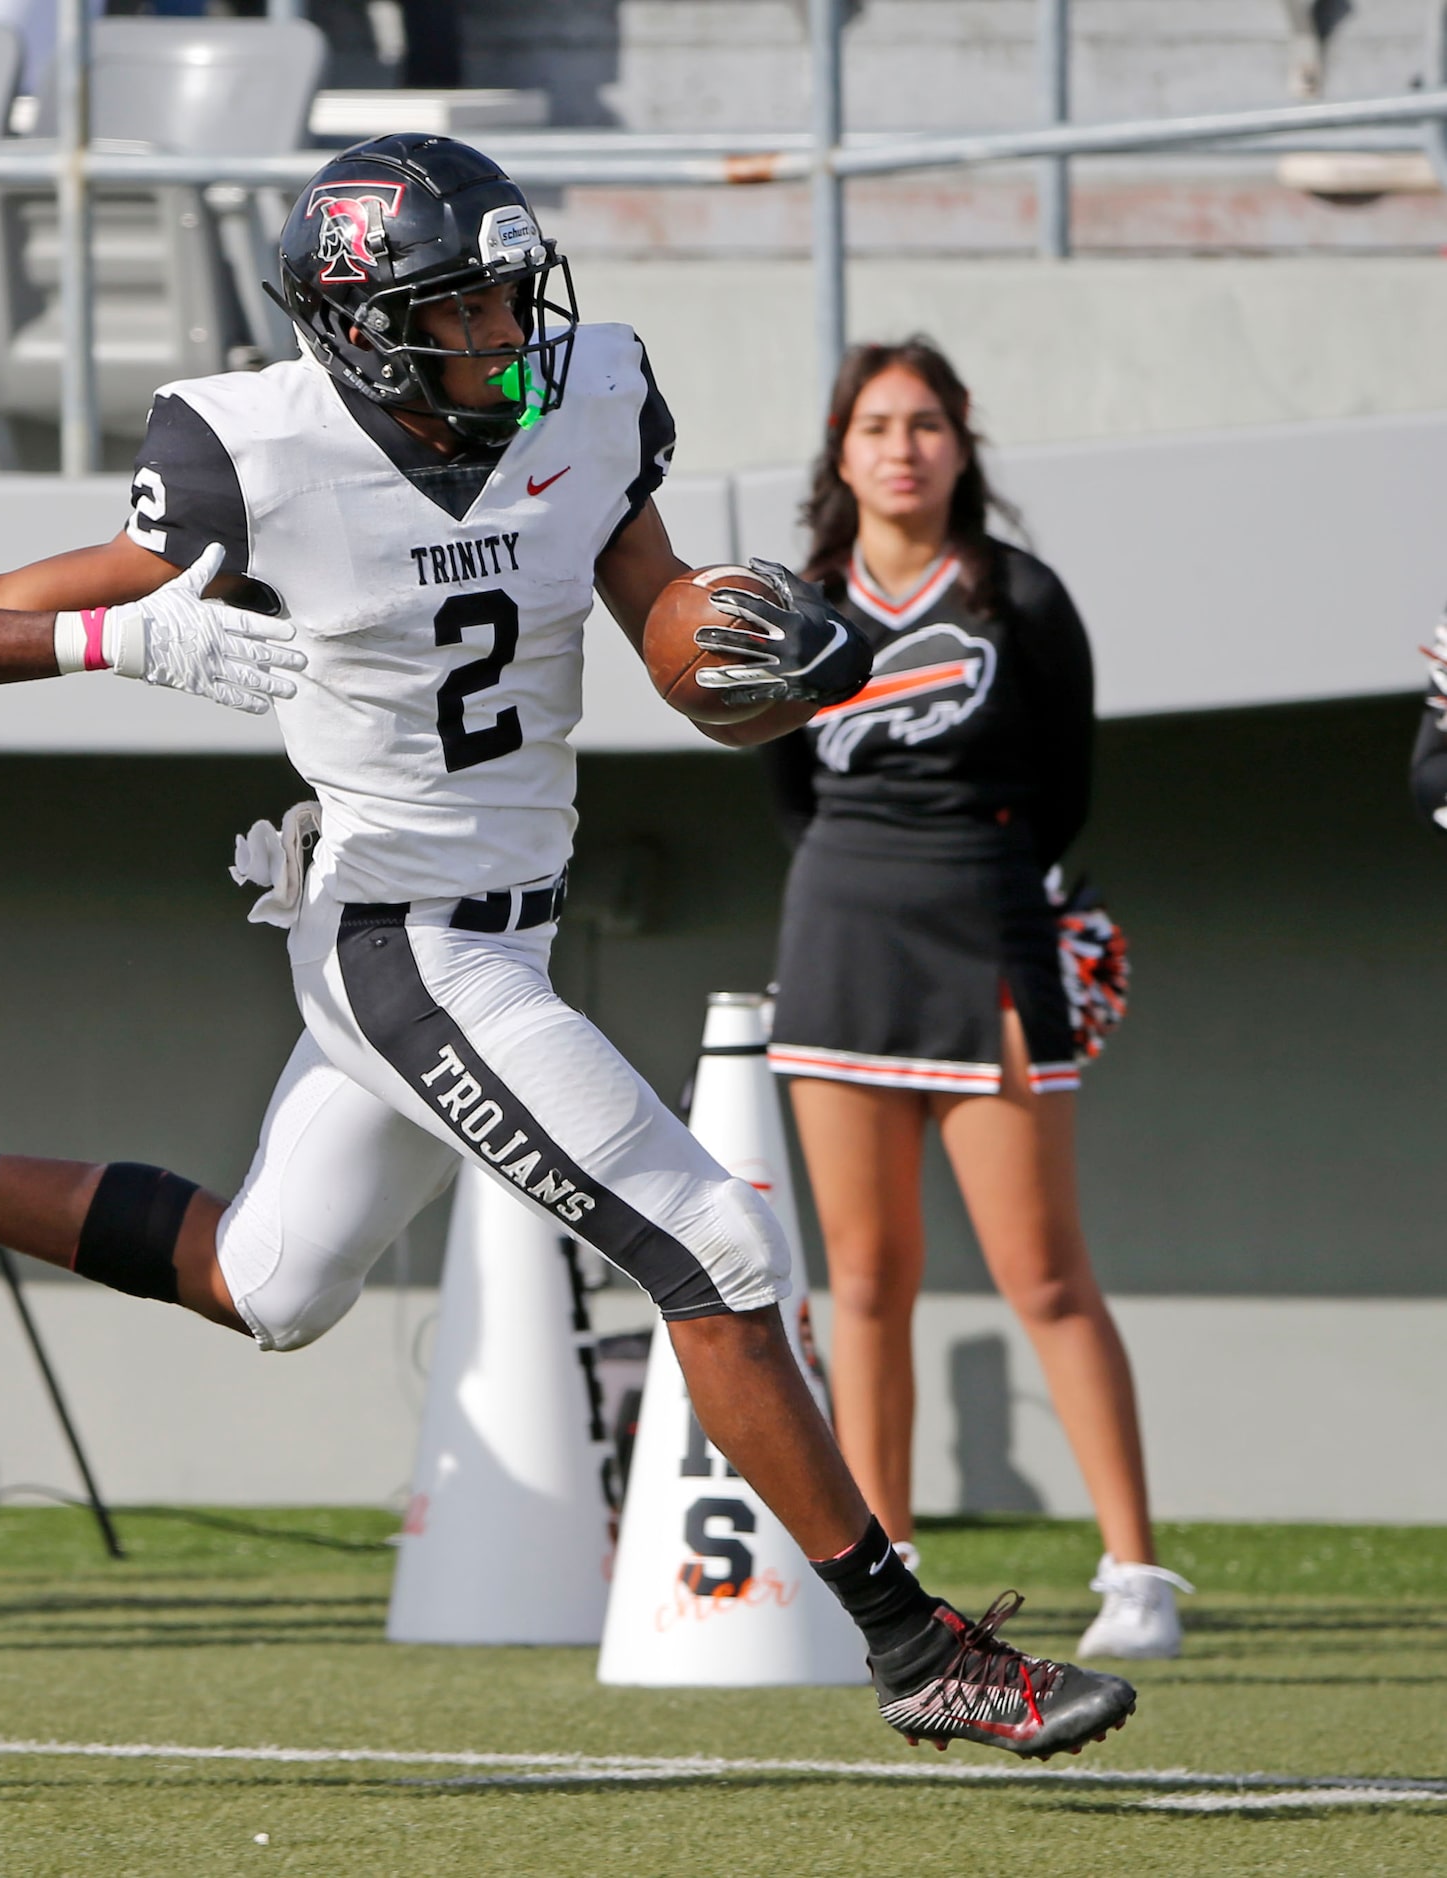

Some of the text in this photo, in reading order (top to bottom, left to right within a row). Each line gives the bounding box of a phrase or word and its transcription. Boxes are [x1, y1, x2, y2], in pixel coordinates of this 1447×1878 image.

[502, 226, 529, 241] schutt
[125, 466, 168, 554] 2
[411, 532, 520, 586] TRINITY
[433, 588, 524, 773] 2
[420, 1043, 596, 1222] TROJANS
[655, 1553, 800, 1633] cheer
